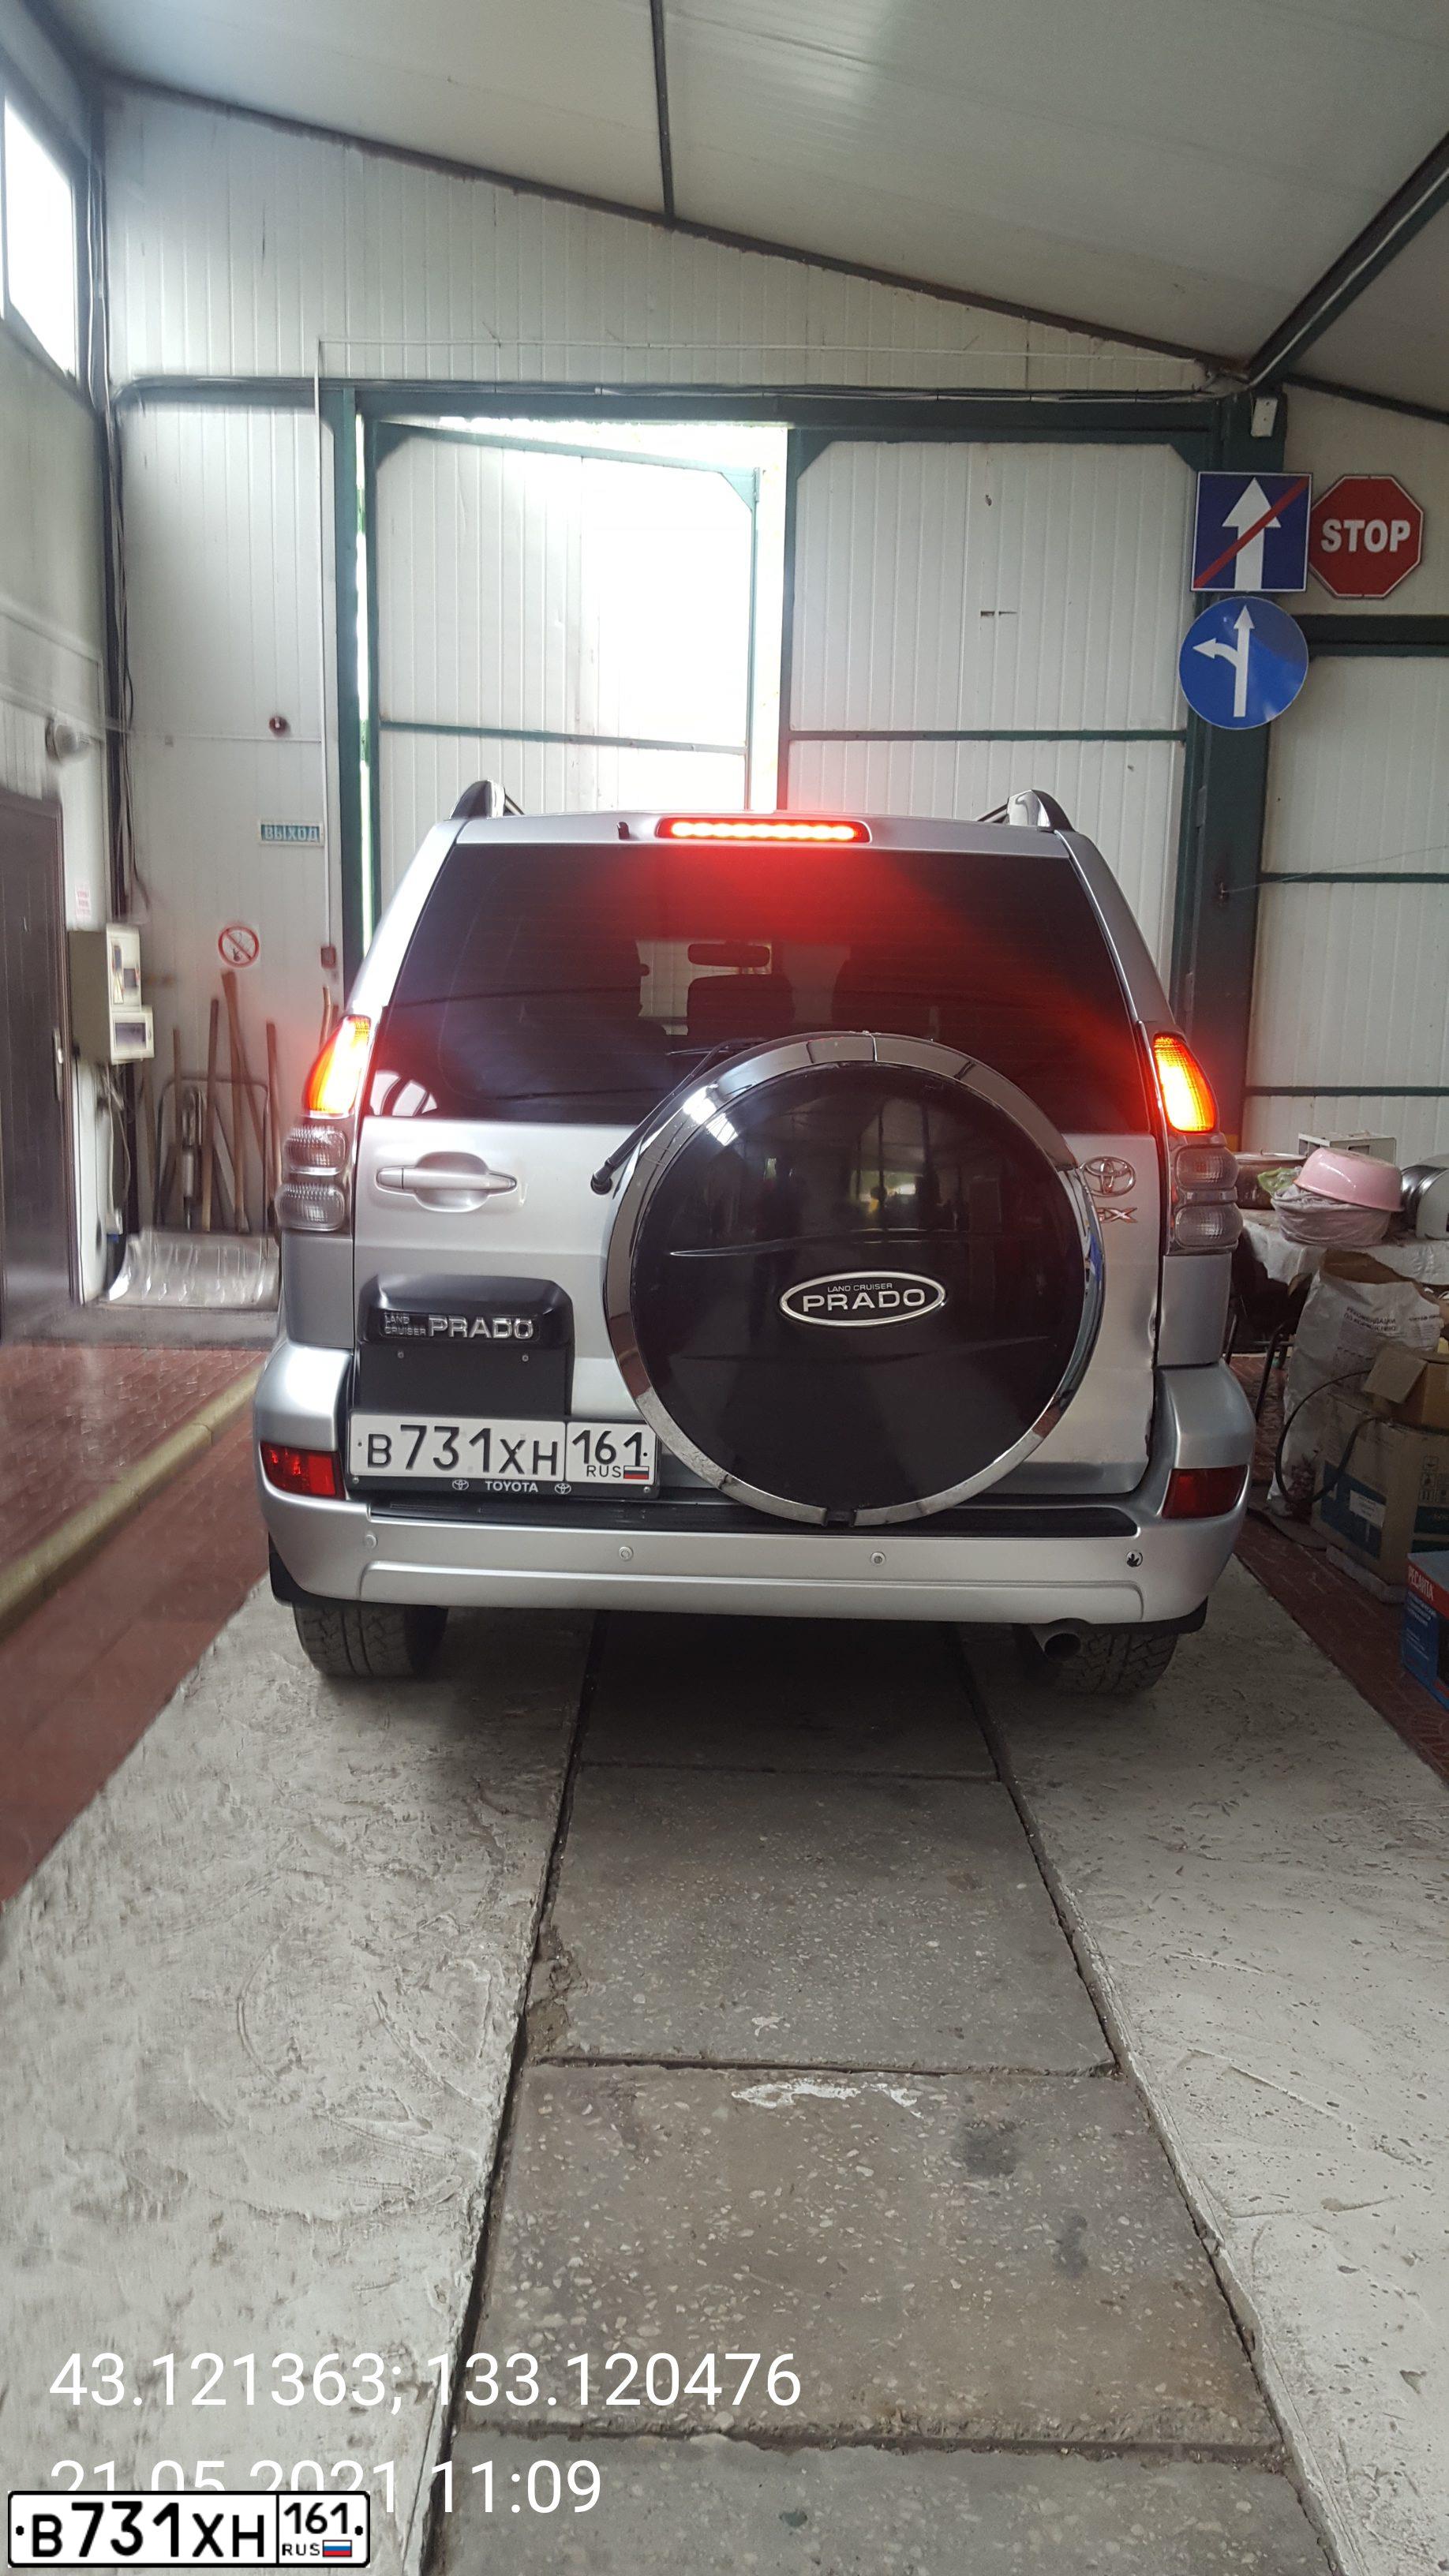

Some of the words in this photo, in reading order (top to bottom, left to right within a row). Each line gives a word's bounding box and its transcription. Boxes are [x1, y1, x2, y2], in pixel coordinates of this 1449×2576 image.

[1320, 519, 1410, 553] STOP
[264, 826, 318, 842] ВЫХОД
[853, 1282, 893, 1292] CRUISER
[802, 1288, 926, 1312] PRADO
[383, 1312, 410, 1324] LAND
[384, 1327, 426, 1336] CRUISER
[428, 1315, 534, 1339] PRADO
[572, 1430, 643, 1468] 161
[586, 1465, 622, 1478] RUS
[485, 1481, 538, 1492] TOYOTA
